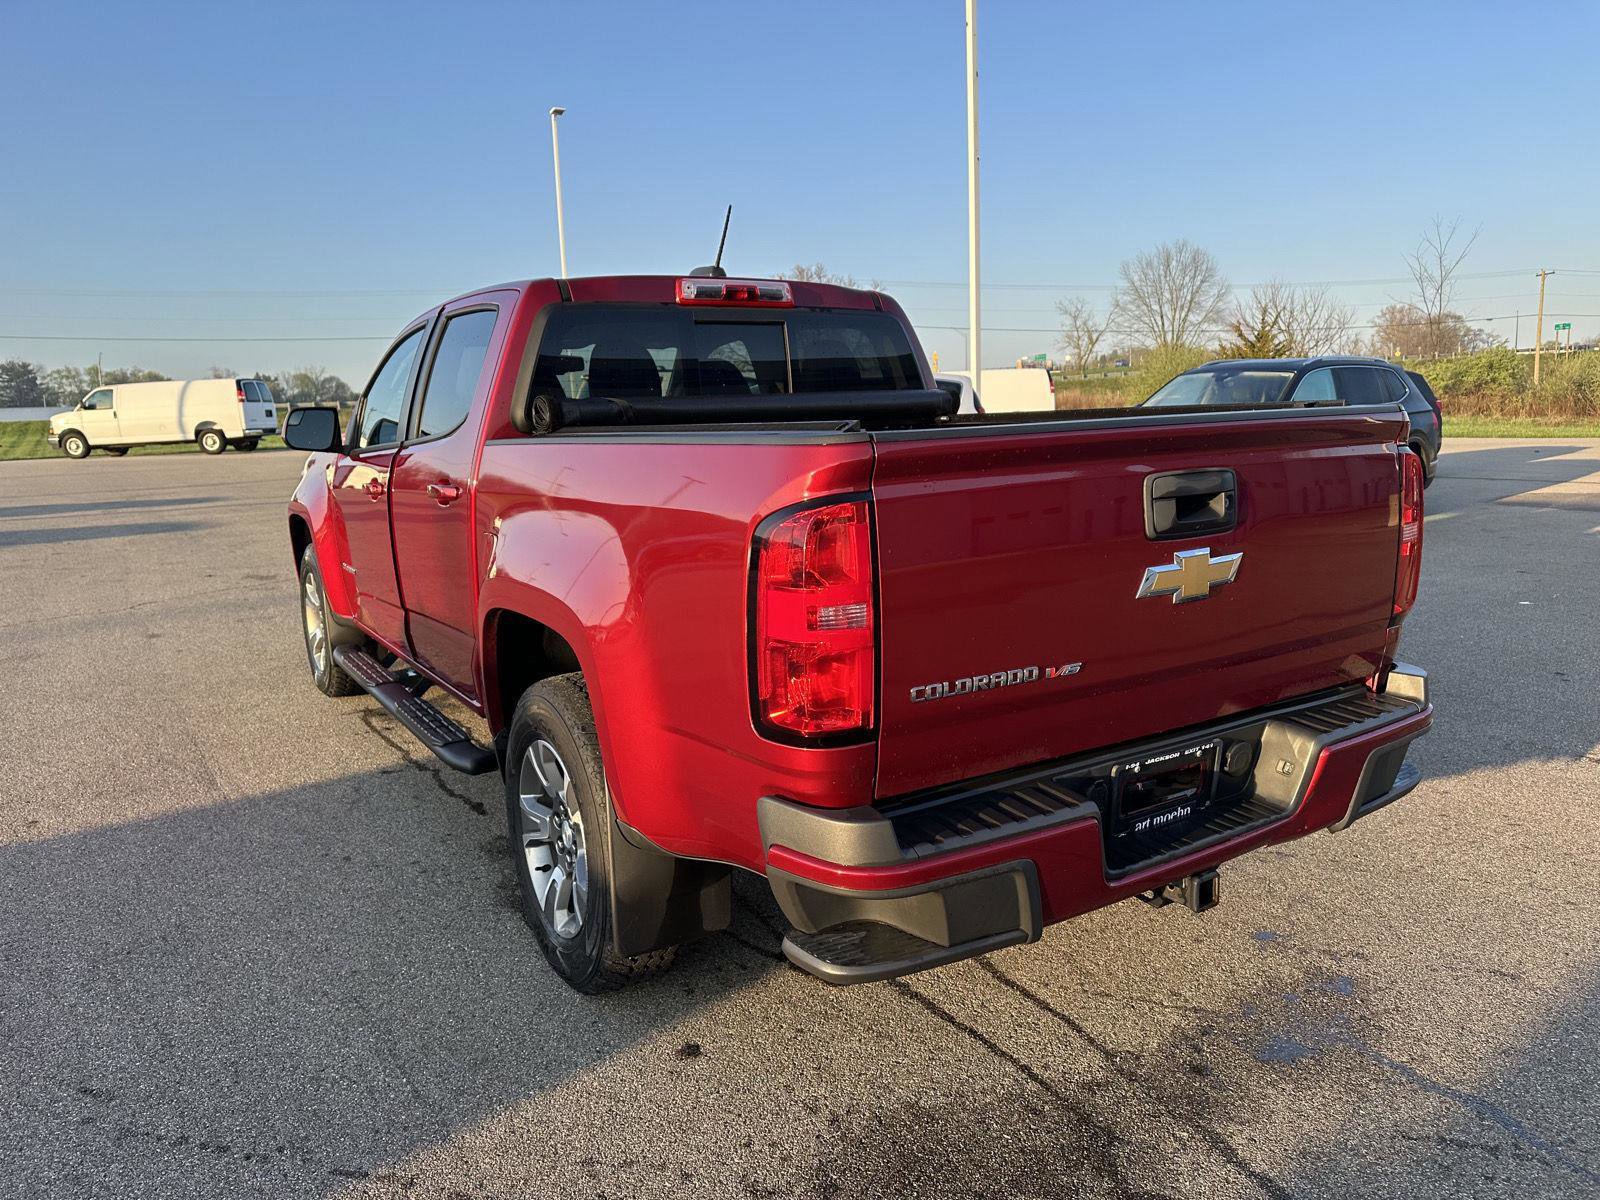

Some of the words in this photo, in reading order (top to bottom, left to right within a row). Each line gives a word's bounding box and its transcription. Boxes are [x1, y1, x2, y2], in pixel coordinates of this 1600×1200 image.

[909, 666, 1039, 703] COLORADO
[1046, 662, 1082, 679] V6
[1145, 752, 1180, 765] JACKSON
[1184, 746, 1201, 755] EXIT
[1135, 818, 1151, 832] art
[1153, 806, 1191, 825] moehn
